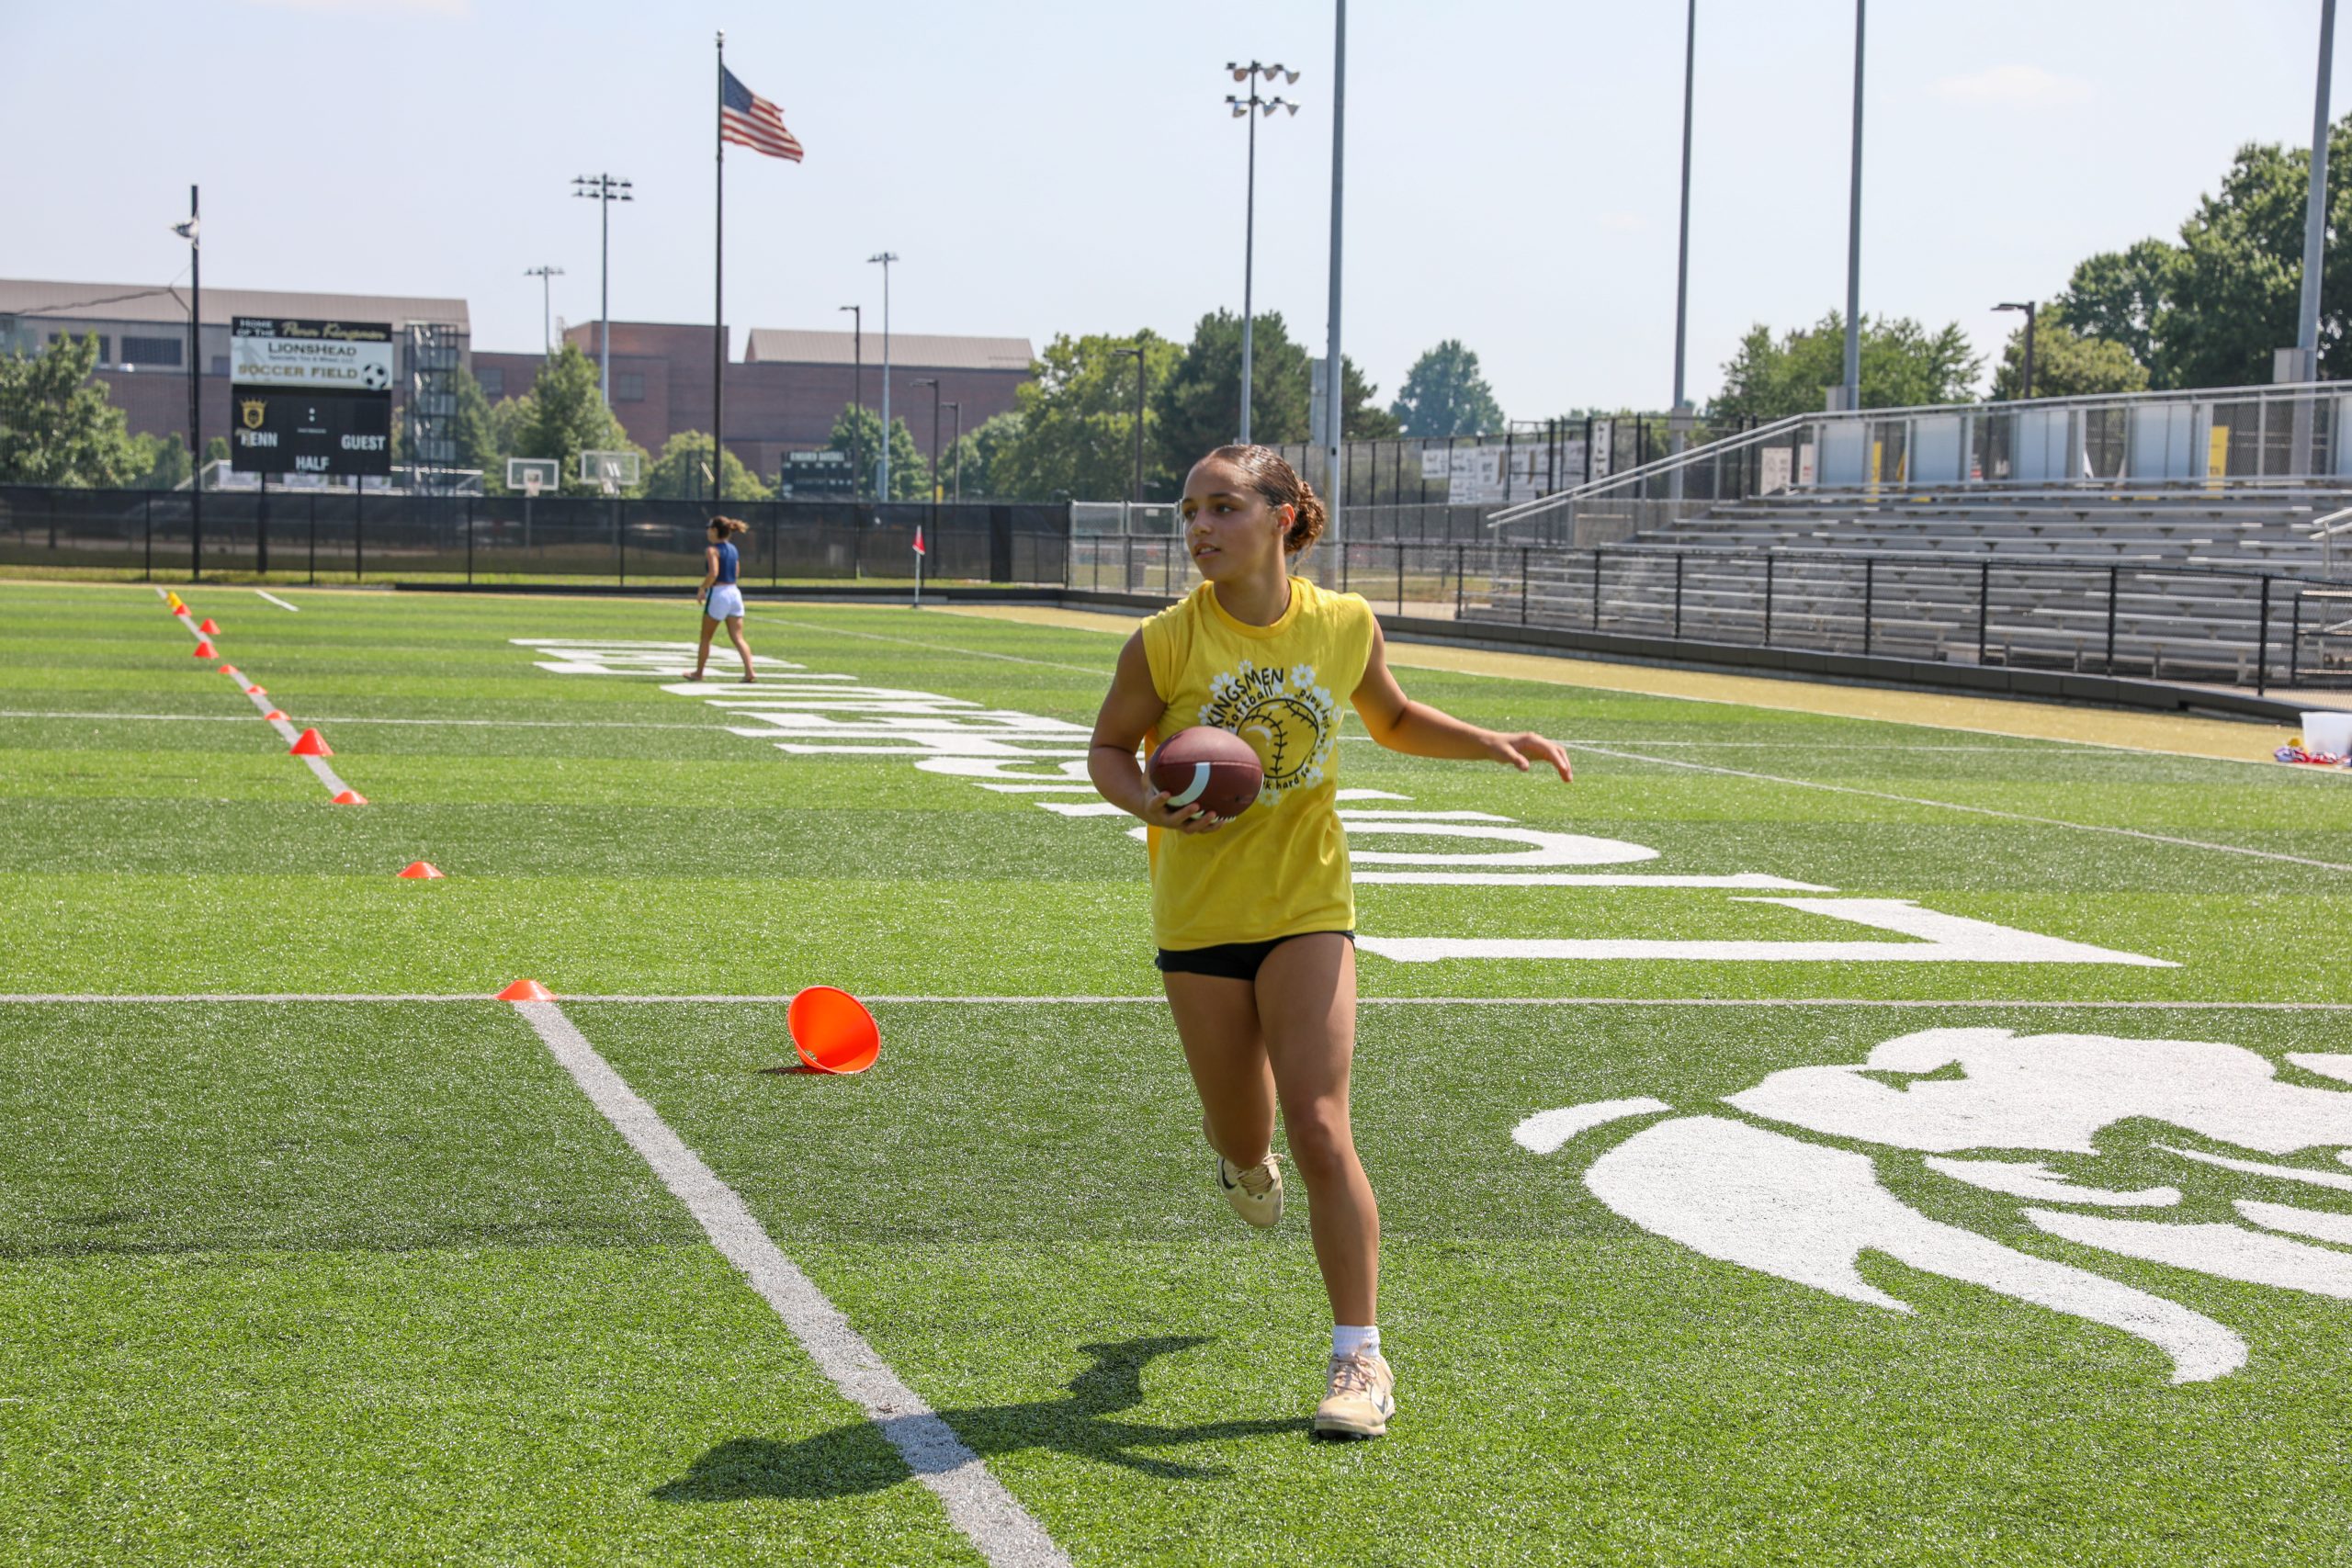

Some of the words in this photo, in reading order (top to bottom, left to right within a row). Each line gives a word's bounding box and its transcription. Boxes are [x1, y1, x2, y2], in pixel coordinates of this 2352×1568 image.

[240, 319, 273, 328] HOME
[238, 364, 304, 377] SOCCER
[311, 366, 358, 379] FIELD
[341, 434, 386, 451] GUEST
[296, 456, 330, 470] HALF
[1207, 667, 1284, 728] KINGSMEN
[1227, 686, 1273, 728] softball
[1276, 773, 1300, 790] hard
